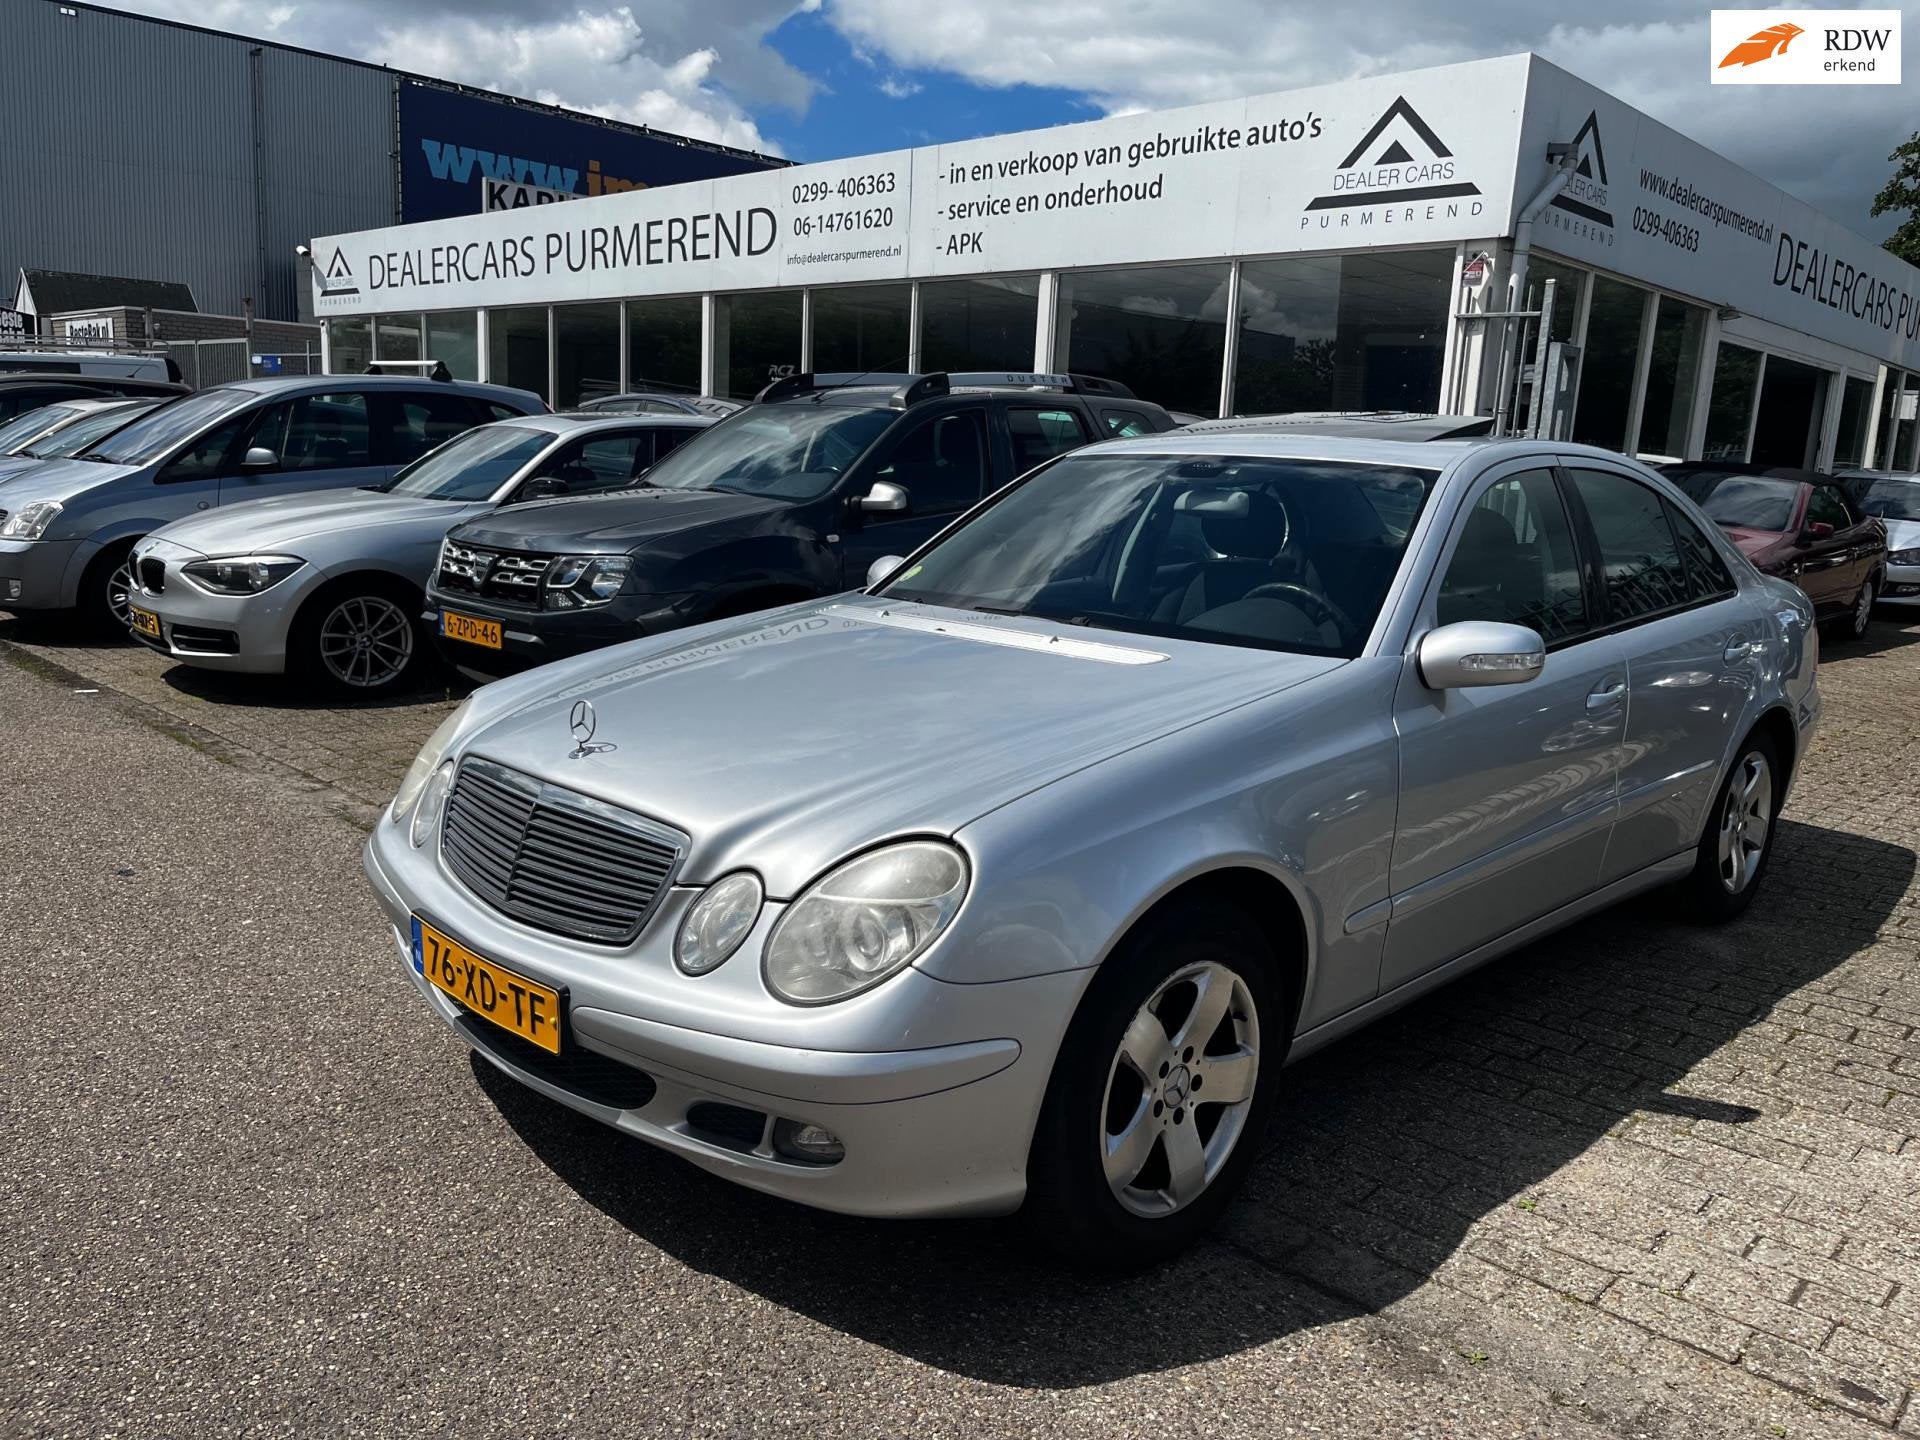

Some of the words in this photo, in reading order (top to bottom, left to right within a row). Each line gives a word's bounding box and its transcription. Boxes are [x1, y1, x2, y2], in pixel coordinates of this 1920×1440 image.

[950, 162, 966, 184] in
[971, 163, 993, 181] en
[998, 150, 1079, 178] verkoop
[1084, 144, 1121, 167] van
[1128, 126, 1241, 168] gebruikte
[1246, 111, 1322, 147] auto's
[837, 172, 896, 198] 406363
[1333, 168, 1400, 191] DEALER
[1405, 162, 1455, 183] CARS
[948, 194, 1011, 220] service
[1016, 194, 1039, 213] en
[1045, 173, 1163, 209] onderhoud
[1564, 177, 1585, 197] ALER
[1586, 184, 1608, 207] CARS
[1640, 168, 1774, 245] www.dealercarspurmerend.nl
[793, 207, 893, 236] 06-14761620
[1300, 201, 1483, 230] PURMEREND
[1545, 212, 1614, 247] URMEREND
[1633, 205, 1700, 253] 0299-406363
[369, 235, 535, 290] DEALERCARS
[546, 207, 777, 275] PURMEREND
[787, 244, 902, 266] info@dealercarspurmerend.nl
[946, 231, 983, 255] APK
[1773, 232, 1897, 330] DEALERCARS
[1007, 374, 1068, 385] DUSTER
[447, 615, 498, 644] 6-ZPD-46
[428, 935, 546, 1036] 76-XD-TF
